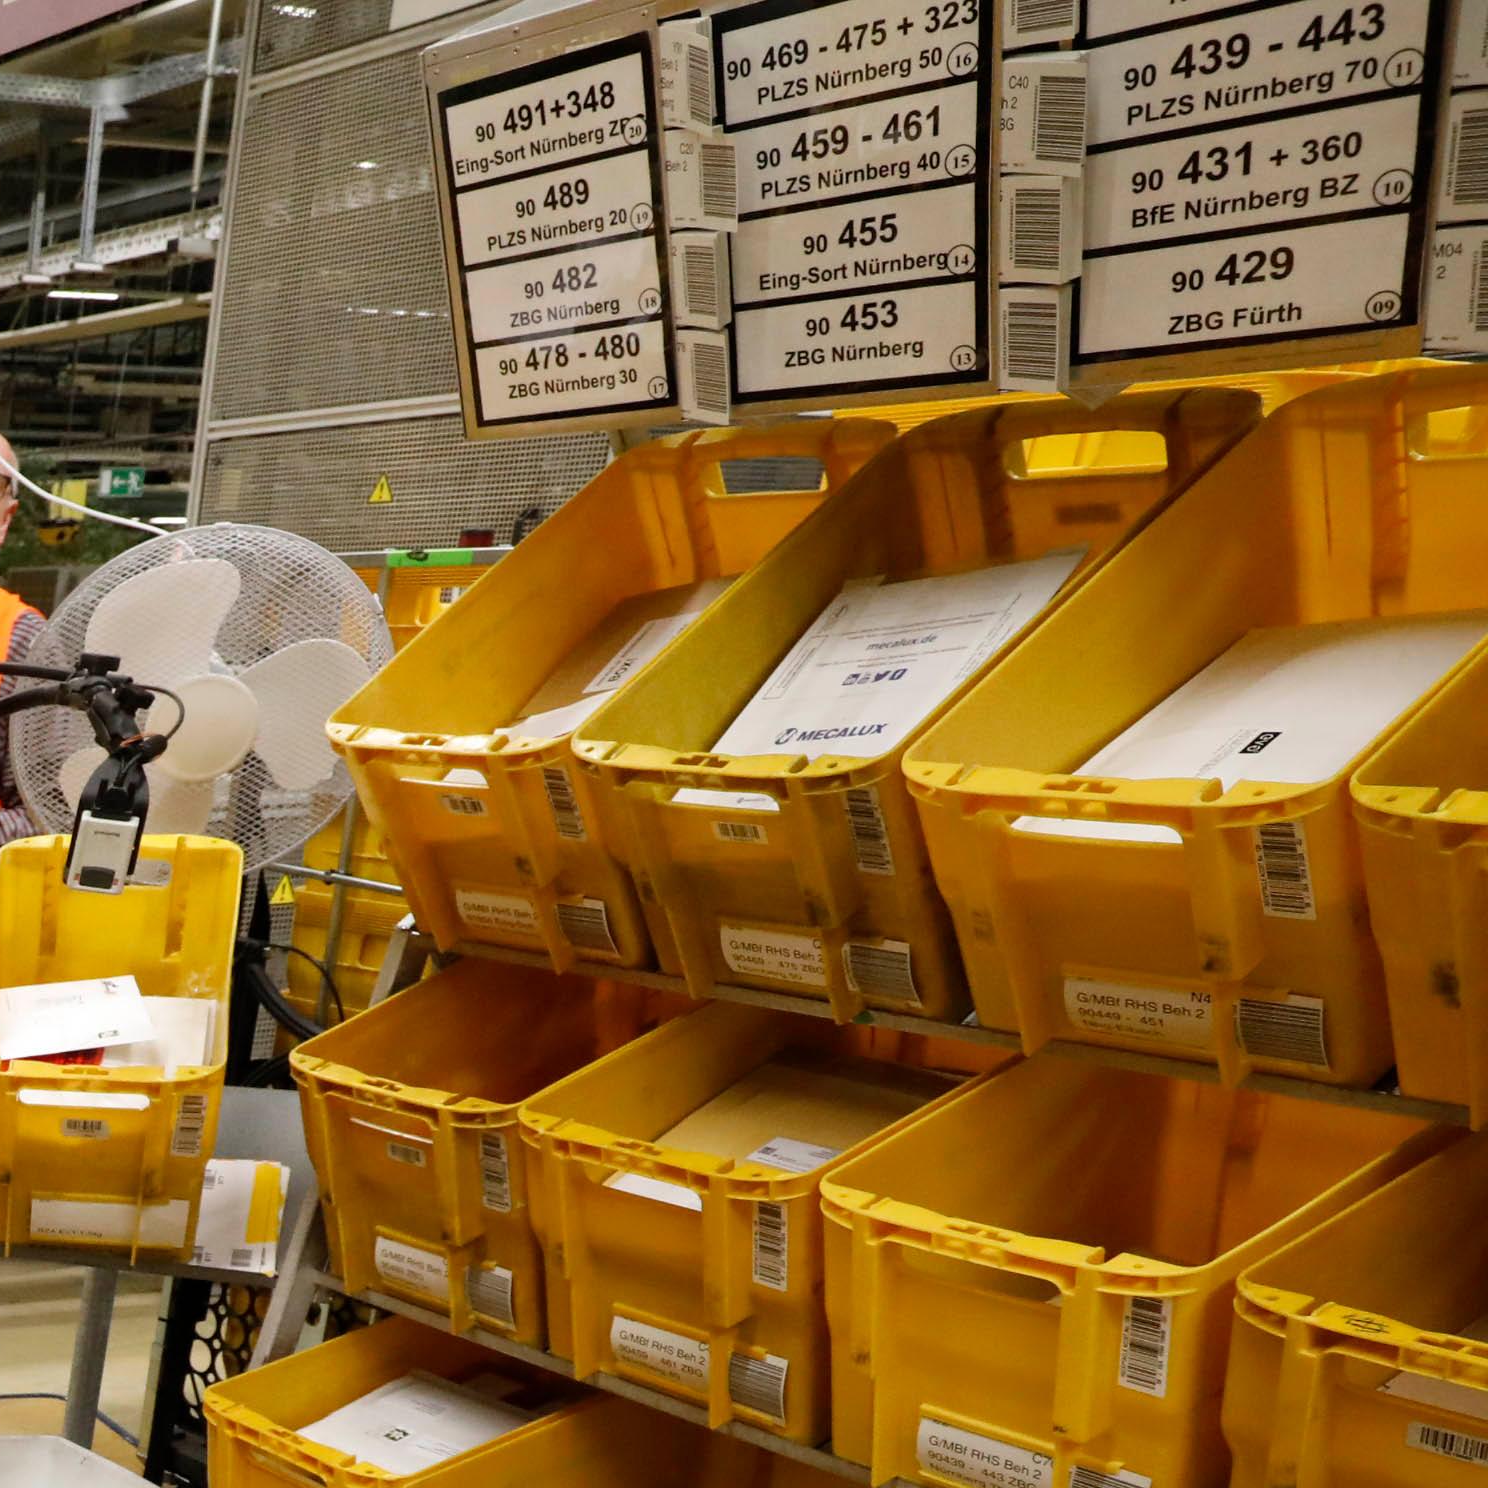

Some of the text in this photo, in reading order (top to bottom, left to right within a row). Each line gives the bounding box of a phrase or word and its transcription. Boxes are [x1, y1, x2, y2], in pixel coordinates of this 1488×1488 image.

[727, 0, 979, 80] 90 469 475 323
[1124, 3, 1385, 91] 90 439 443
[758, 47, 942, 105] PLZS Nürnberg 50
[1009, 76, 1029, 89] C40
[1396, 61, 1412, 78] 11
[476, 83, 616, 142] 90 491+348
[1128, 57, 1378, 126] PLZS Nürnberg 70
[456, 128, 604, 175] Eing-Sort Nürnberg
[757, 106, 943, 170] 90 459 461
[761, 151, 940, 199] PLZS Nürnberg 40
[1132, 132, 1362, 194] 90 431 360
[516, 179, 589, 218] 90 489
[1132, 174, 1359, 228] BfE Nürnberg BZ
[1384, 181, 1404, 196] 10
[488, 208, 627, 251] PLZS Nürnberg 20
[804, 213, 897, 255] 90 455
[524, 263, 597, 299] 90 482
[760, 251, 949, 291] Eing-Sort Nürnberg
[1172, 247, 1294, 293] 90 429
[510, 299, 620, 328] ZBG Nürnberg
[806, 300, 898, 337] 90 453
[1168, 302, 1302, 335] ZBG Fürth
[1373, 300, 1395, 314] 09
[499, 333, 640, 375] 90 478 480
[785, 341, 923, 367] ZBG Nürnberg
[508, 368, 637, 399] ZBG Nürnberg 30
[796, 722, 888, 742] MECALUX
